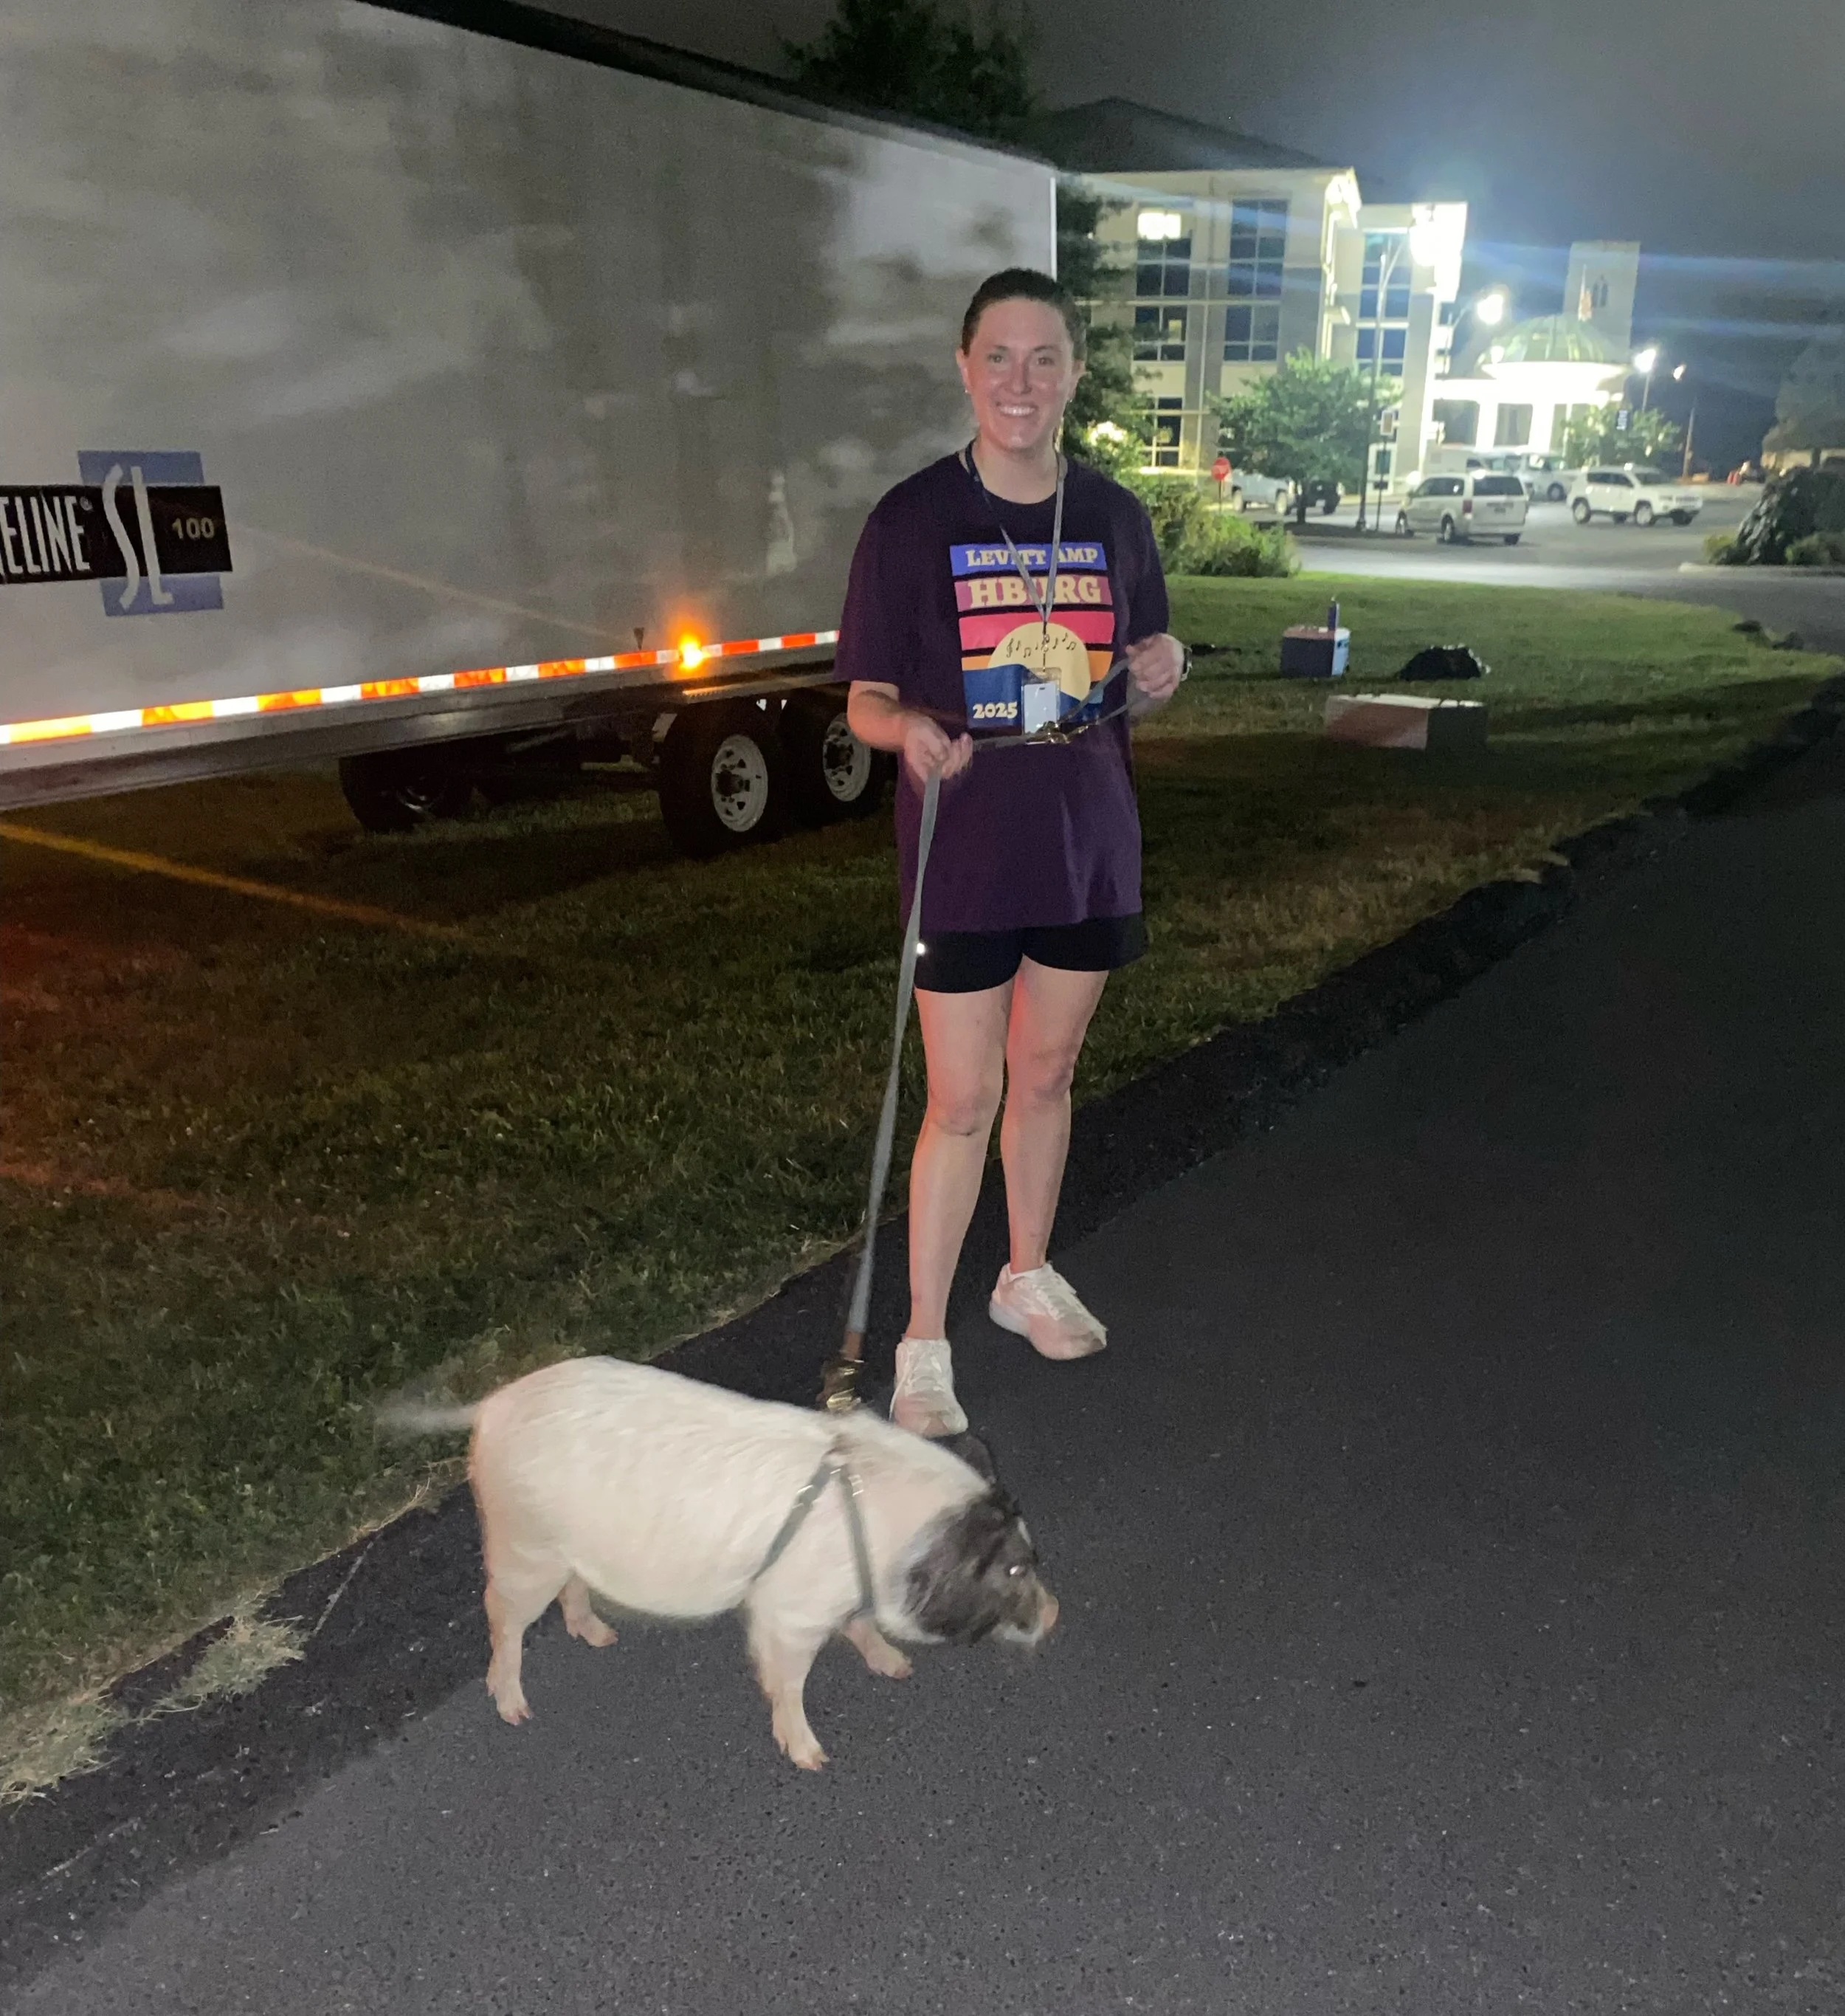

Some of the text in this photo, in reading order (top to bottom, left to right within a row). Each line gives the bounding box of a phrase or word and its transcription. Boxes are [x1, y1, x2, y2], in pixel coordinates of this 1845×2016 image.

[103, 463, 175, 610] SL
[171, 517, 215, 540] 100
[965, 549, 1046, 567] LEVTT
[973, 702, 1018, 718] 2025
